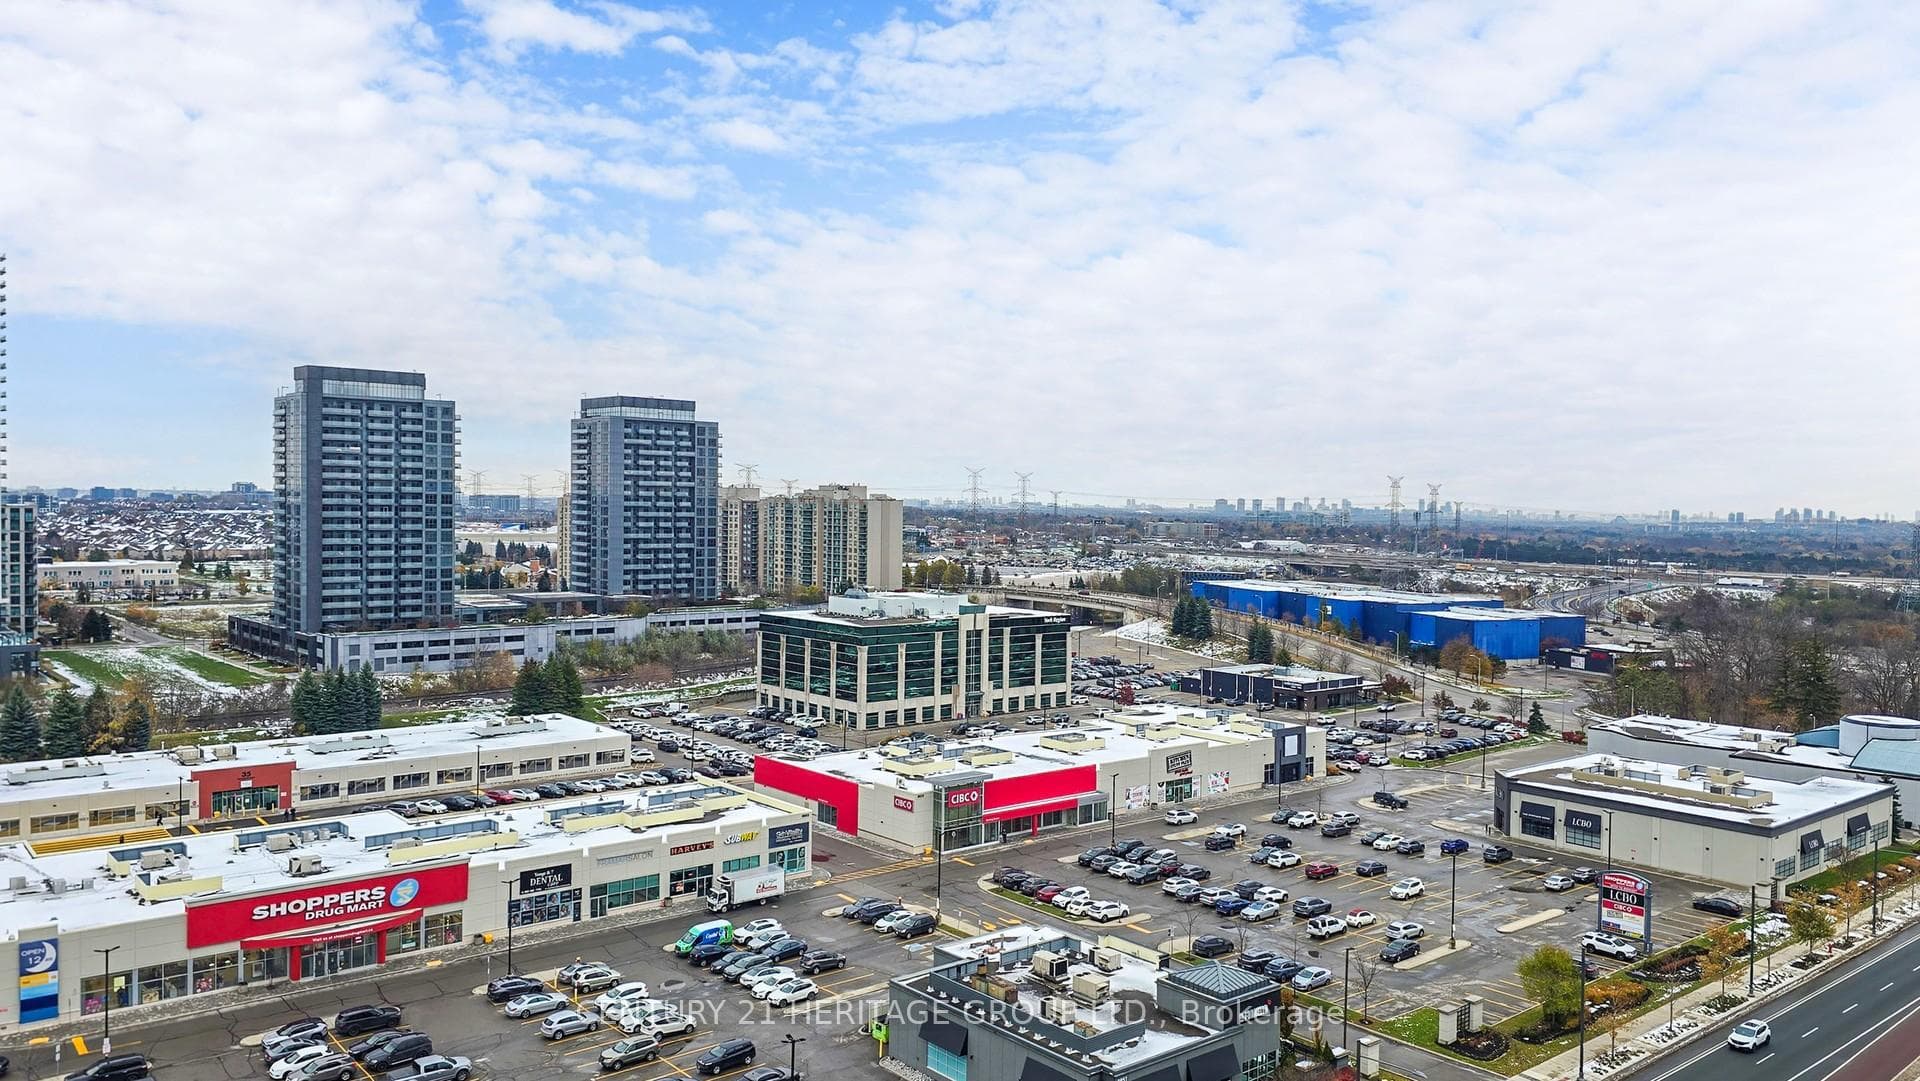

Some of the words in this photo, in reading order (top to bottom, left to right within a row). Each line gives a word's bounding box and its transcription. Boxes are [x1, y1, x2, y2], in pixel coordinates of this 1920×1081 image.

[894, 798, 907, 808] CIBC
[951, 792, 970, 804] CIBC
[1572, 817, 1592, 828] LCBO
[724, 831, 760, 845] SUBWAY
[671, 841, 714, 855] HARVEY'S
[530, 873, 564, 887] DENTAL
[251, 886, 387, 921] SHOPPERS
[1610, 889, 1637, 905] LCBO
[305, 908, 344, 921] DRUG
[347, 899, 385, 914] MART
[21, 948, 45, 957] OPEN
[28, 956, 42, 965] 12
